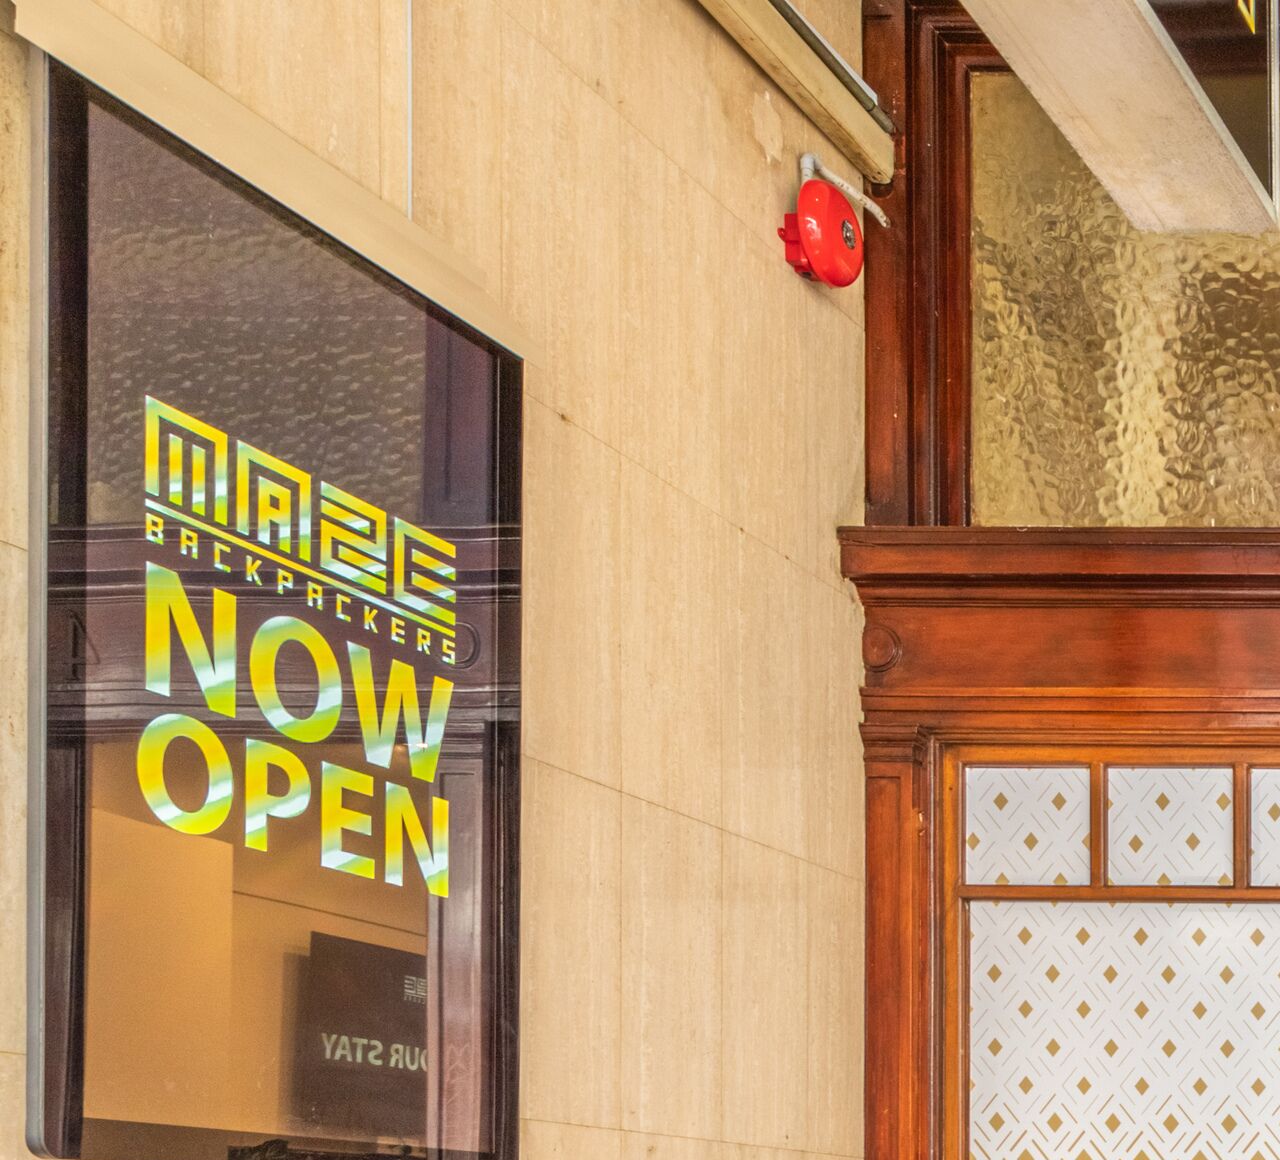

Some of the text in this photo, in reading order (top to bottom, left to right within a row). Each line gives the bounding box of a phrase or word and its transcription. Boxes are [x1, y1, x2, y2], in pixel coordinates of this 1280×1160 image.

[144, 395, 457, 626] MAZE
[145, 512, 457, 666] BACKPACKERS
[145, 561, 453, 784] NOW
[136, 713, 450, 899] OPEN
